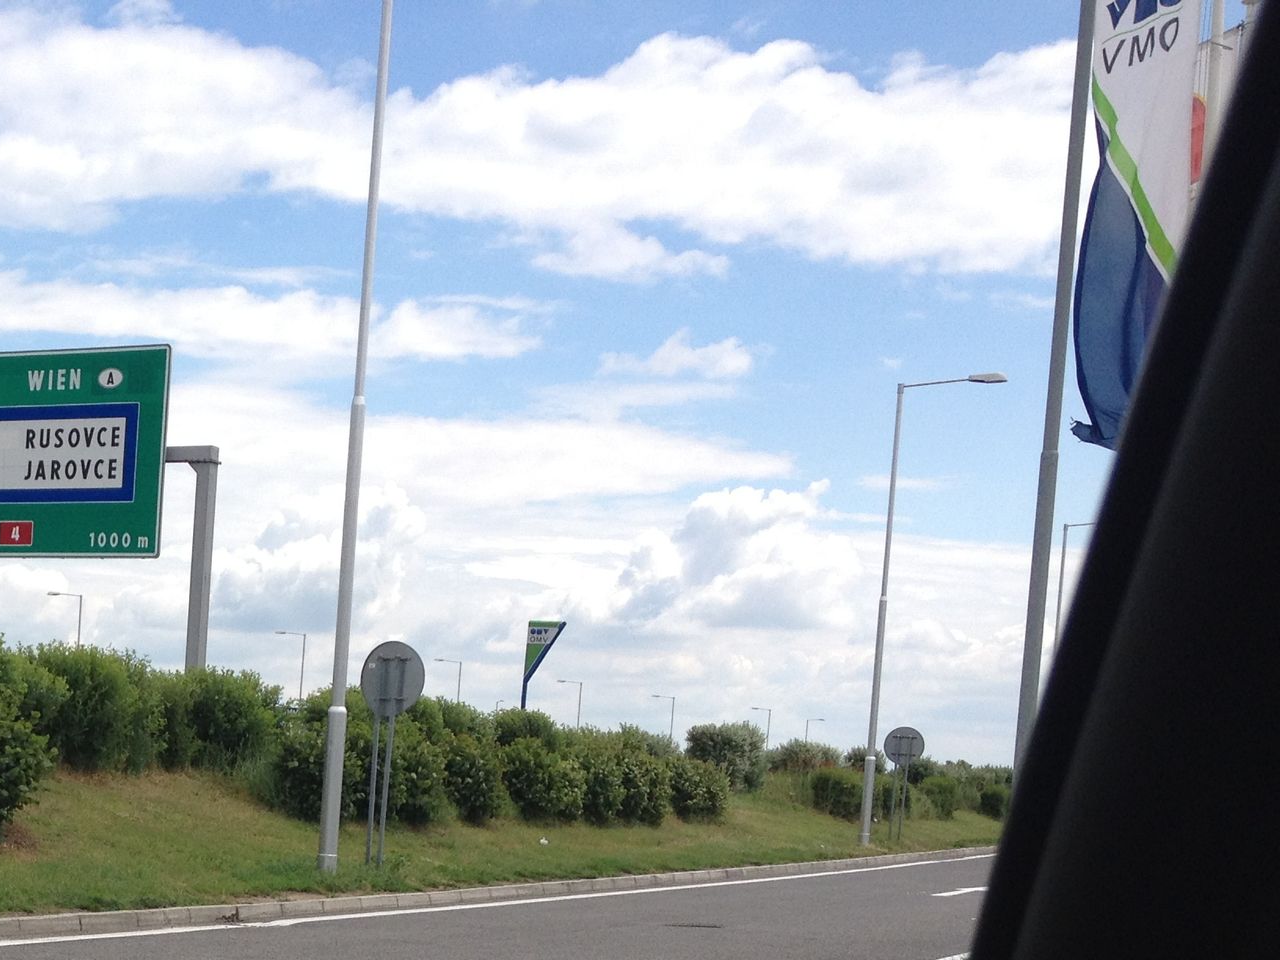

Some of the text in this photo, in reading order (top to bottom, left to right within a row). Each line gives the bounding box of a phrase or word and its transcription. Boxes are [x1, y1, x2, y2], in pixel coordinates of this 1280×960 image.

[28, 368, 115, 391] WIEN A
[25, 426, 120, 450] RUSOVCE
[23, 458, 117, 481] JAROVCE
[11, 526, 20, 541] 4
[89, 532, 149, 548] 1000 m
